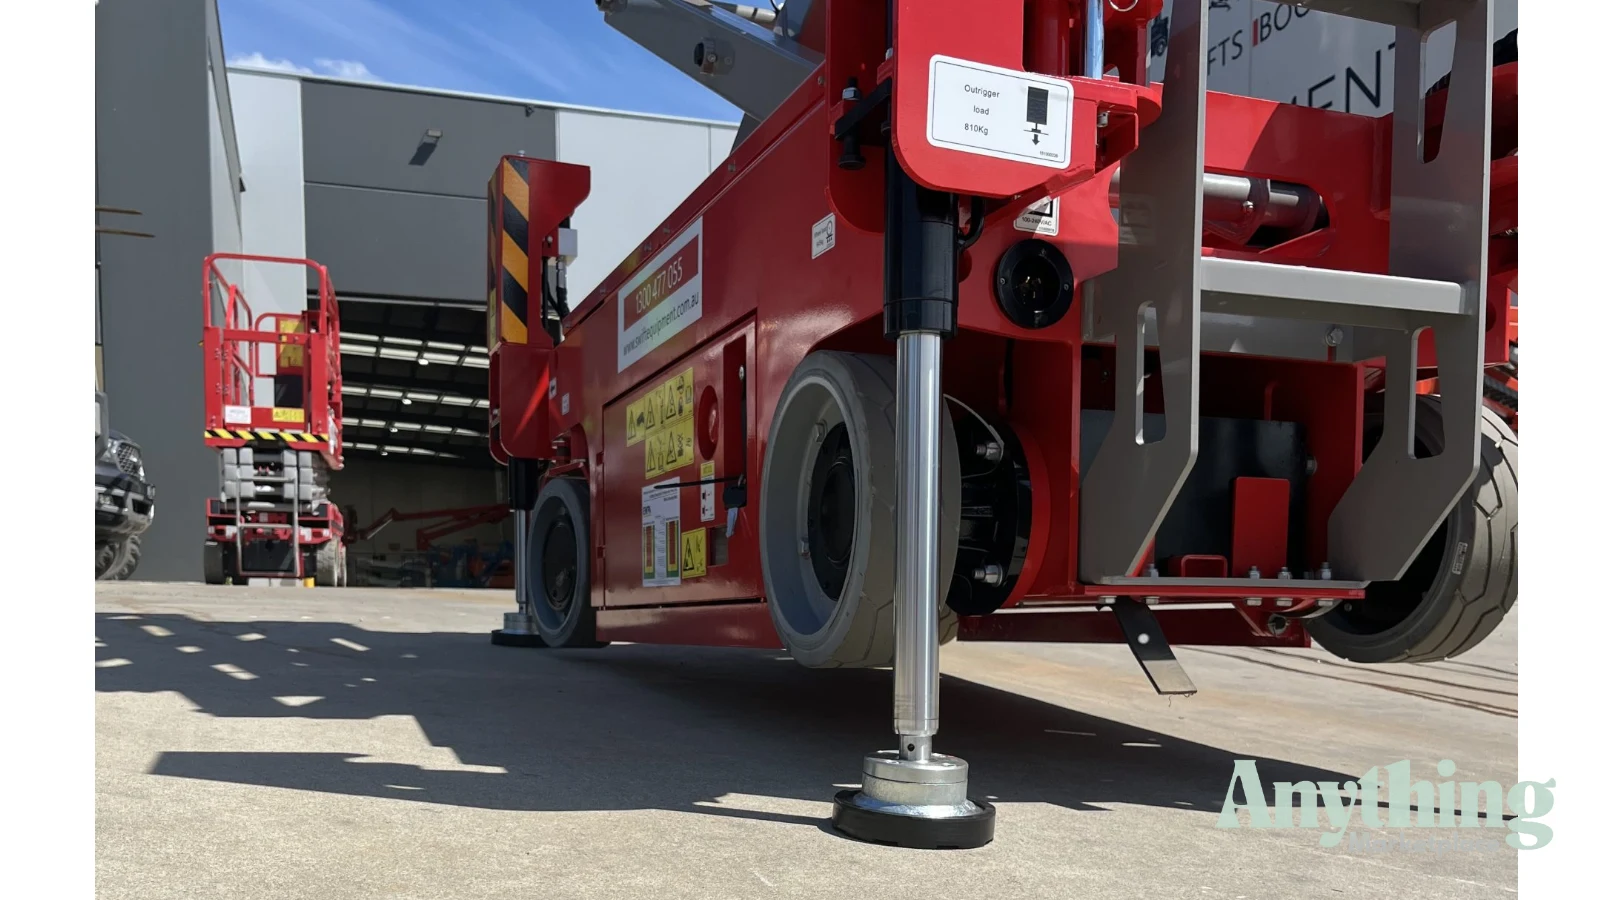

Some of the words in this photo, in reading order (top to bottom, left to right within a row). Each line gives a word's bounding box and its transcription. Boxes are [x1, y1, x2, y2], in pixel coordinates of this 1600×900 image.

[964, 84, 1000, 98] Outrigger
[973, 105, 990, 115] load
[964, 123, 989, 136] 810Kg
[635, 285, 651, 314] 1300
[652, 271, 666, 301] 477
[667, 256, 683, 289] 055
[623, 291, 699, 357] www.swiftequipment.com.au
